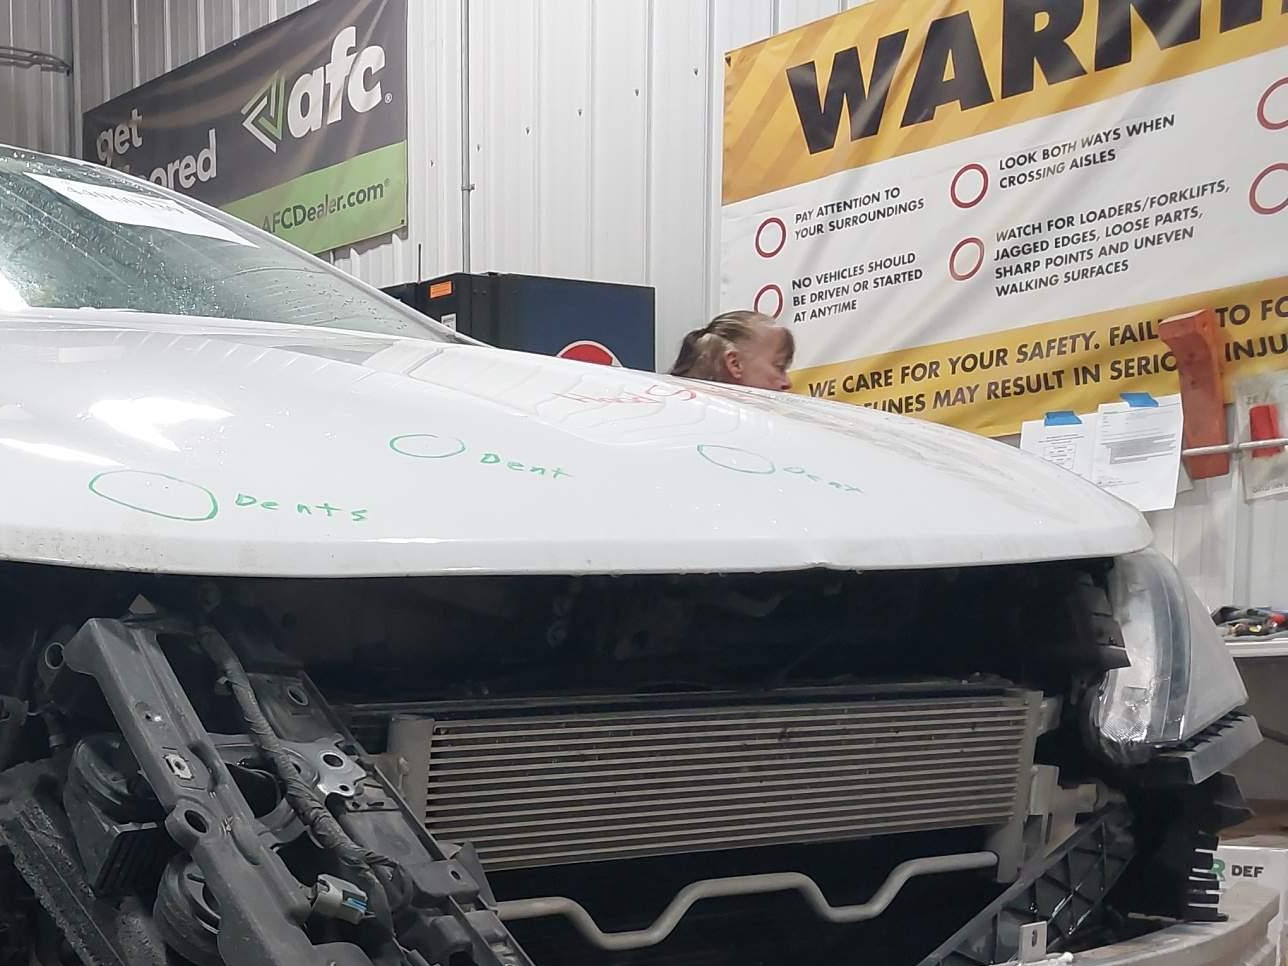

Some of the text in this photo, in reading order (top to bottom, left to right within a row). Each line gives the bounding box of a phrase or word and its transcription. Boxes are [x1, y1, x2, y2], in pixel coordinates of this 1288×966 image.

[287, 26, 387, 138] afc
[96, 108, 143, 167] get
[999, 114, 1175, 171] LOOK BOTH WAYS WHEN
[999, 149, 1116, 189] CROSSING AISLES
[262, 182, 384, 233] AFCDealer.com
[795, 187, 900, 224] PAY ATTENTION TO
[795, 198, 925, 240] YOUR SURROUNDINGS
[996, 180, 1230, 242] WATCH FOR LOADERS/FORKLIFTS,
[994, 205, 1203, 261] JAGGED EDGES, LOOSE PARTS,
[995, 227, 1194, 280] SHARP POINTS AND UNEVEN
[792, 253, 916, 290] NO VEHICLES SHOULD
[793, 268, 923, 306] BE DRIVEN OR STARTED
[995, 260, 1129, 297] WALKING SURFACES
[794, 300, 857, 323] AT ANYTIME
[809, 379, 836, 398] WE
[842, 369, 893, 393] CARE
[901, 360, 940, 384] FOR
[948, 347, 1008, 375] YOUR
[1016, 331, 1100, 363] SAFETY.
[1109, 319, 1162, 347] FAIL
[1215, 304, 1250, 328] TO
[933, 384, 980, 410] MAY
[986, 369, 1065, 400] RESULT
[1074, 364, 1100, 386] IN
[1110, 352, 1178, 380] SERIO
[480, 453, 574, 479] Dent
[235, 493, 368, 522] Dents
[1231, 864, 1264, 878] DEF
